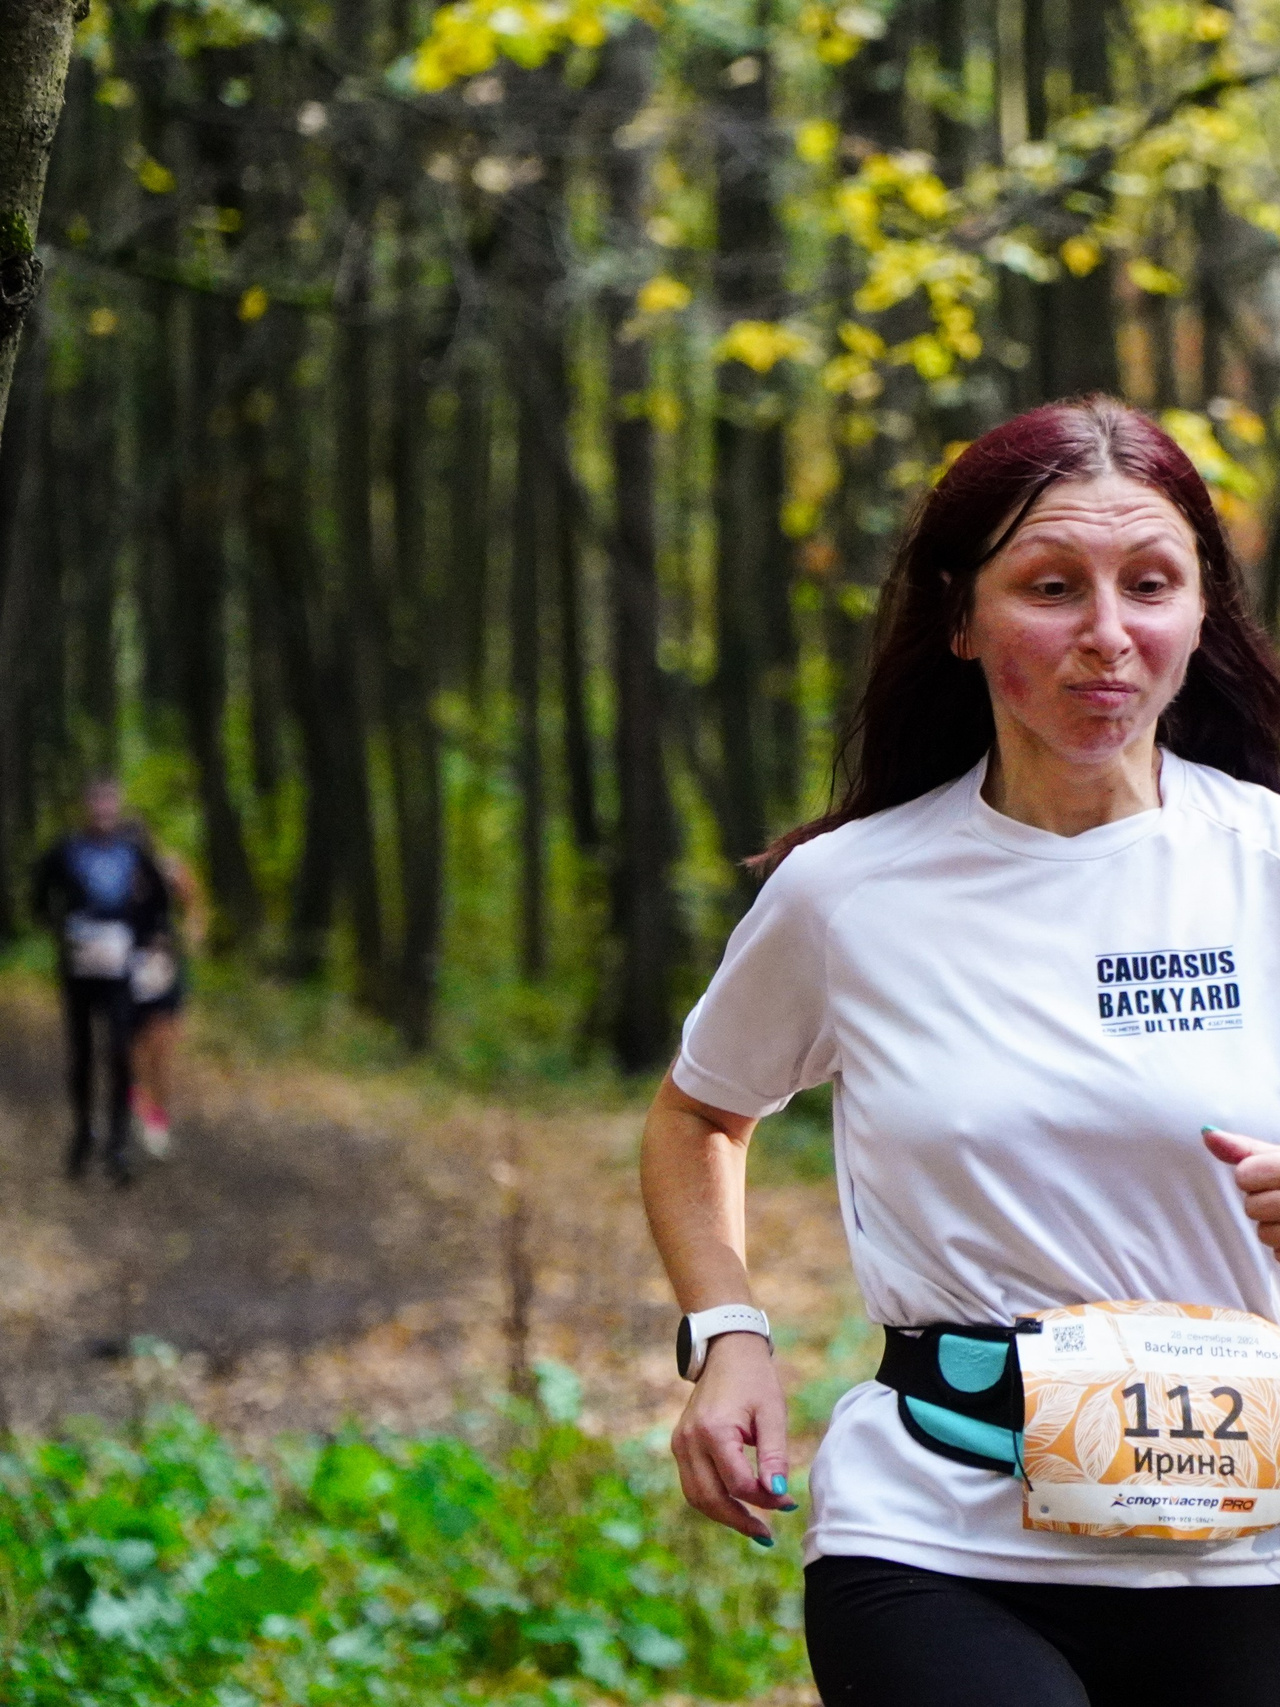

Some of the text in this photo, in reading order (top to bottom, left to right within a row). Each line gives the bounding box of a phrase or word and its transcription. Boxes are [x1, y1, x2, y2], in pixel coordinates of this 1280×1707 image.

[1097, 950, 1236, 983] CAUCASUS
[1098, 983, 1241, 1019] BACKYARD
[1145, 1017, 1204, 1033] ULTRA
[1144, 1341, 1203, 1356] Backyard
[1211, 1346, 1248, 1358] Ultra
[1170, 1330, 1182, 1339] 28
[1187, 1333, 1232, 1344] сентября
[1121, 1382, 1249, 1441] 112
[1134, 1447, 1235, 1480] Ирина
[1222, 1499, 1255, 1511] PRO
